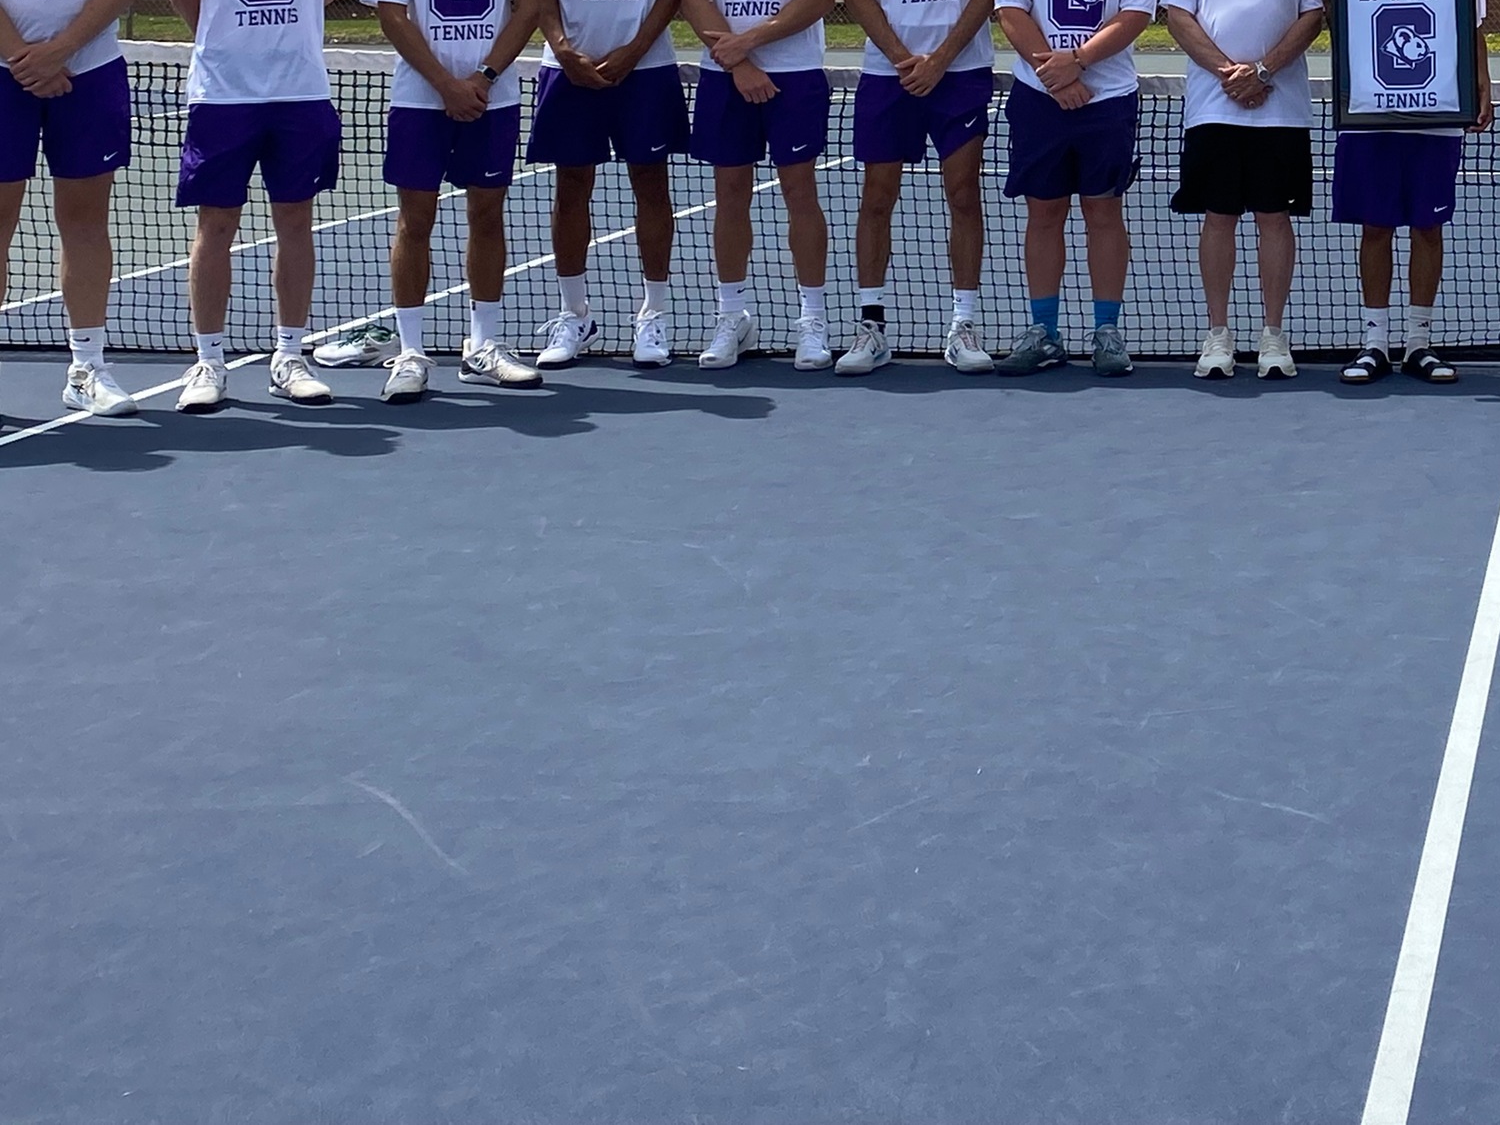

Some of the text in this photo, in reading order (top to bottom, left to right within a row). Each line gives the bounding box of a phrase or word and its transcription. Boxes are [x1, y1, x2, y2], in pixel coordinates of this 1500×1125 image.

[724, 1, 780, 17] TENNIS
[235, 9, 298, 27] TENNIS
[430, 24, 494, 41] TENNIS
[1048, 34, 1093, 49] TEN
[1376, 92, 1438, 108] TENNIS
